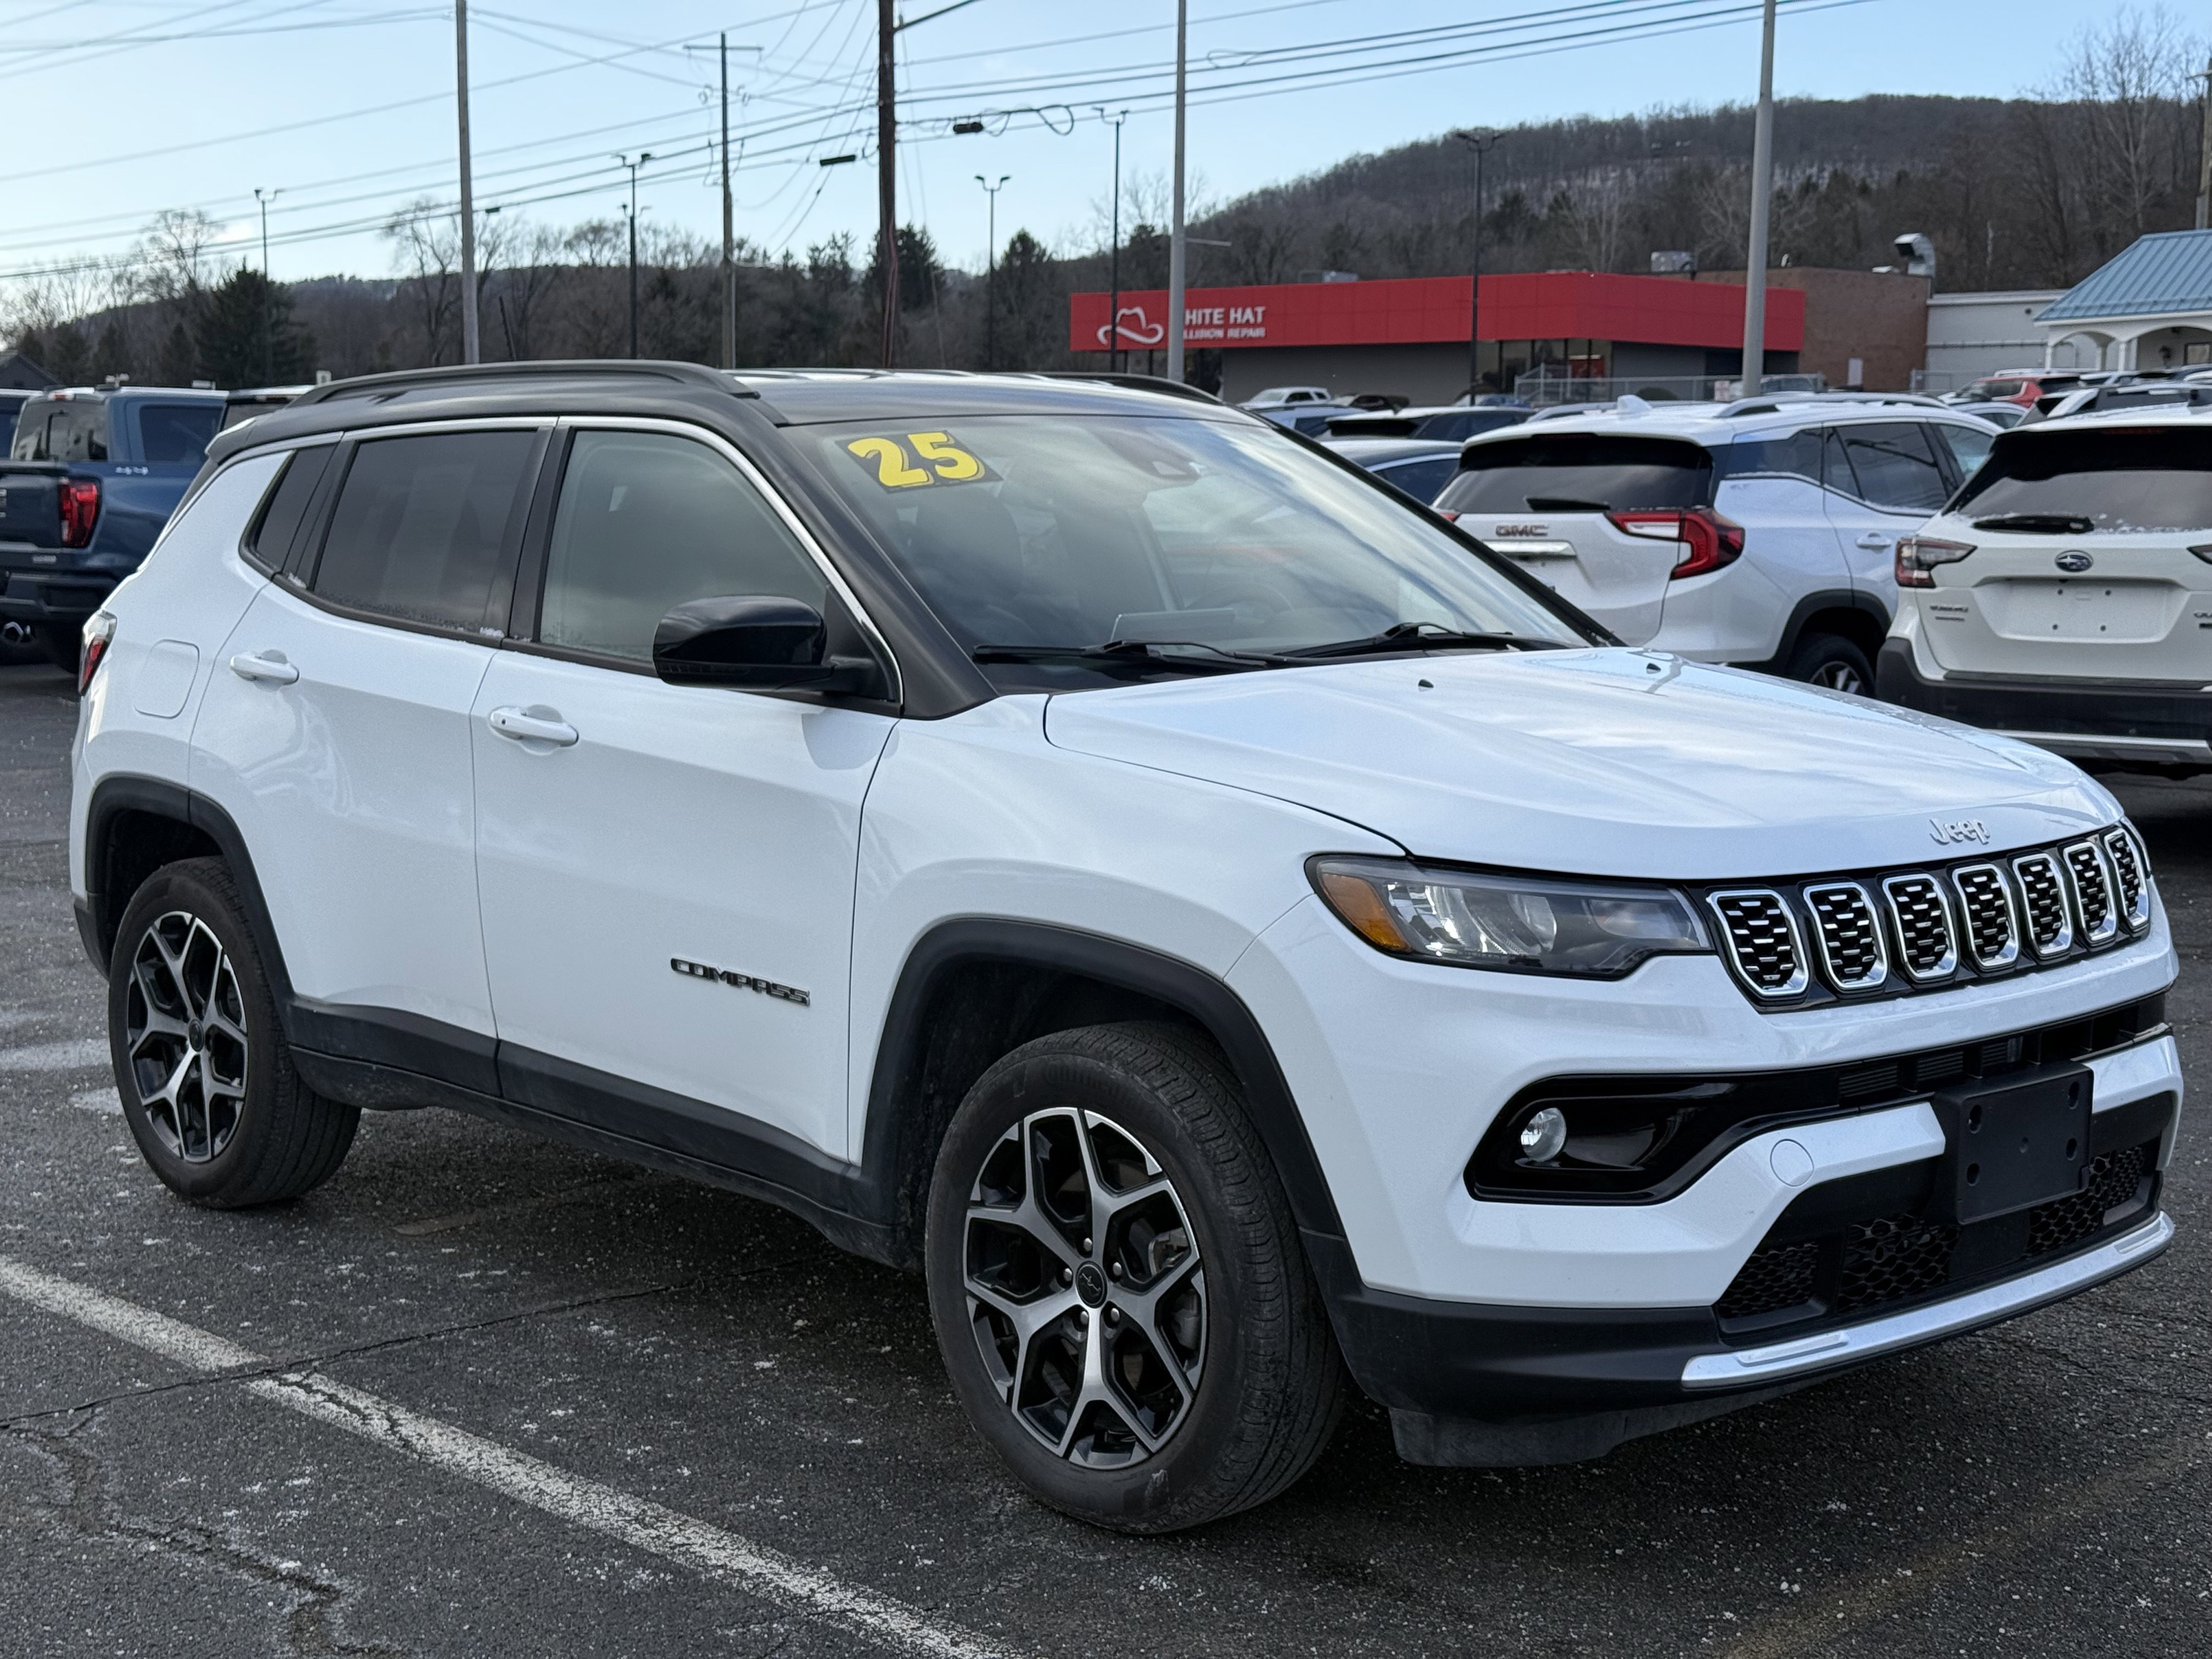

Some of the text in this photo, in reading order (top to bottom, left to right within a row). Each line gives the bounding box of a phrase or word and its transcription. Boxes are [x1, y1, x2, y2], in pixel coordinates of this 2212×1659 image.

[1184, 306, 1266, 325] HITE HAT
[847, 431, 986, 487] 25
[1496, 524, 1549, 537] GMC
[1929, 817, 1991, 845] Jeep
[670, 956, 811, 1007] COMPASS
